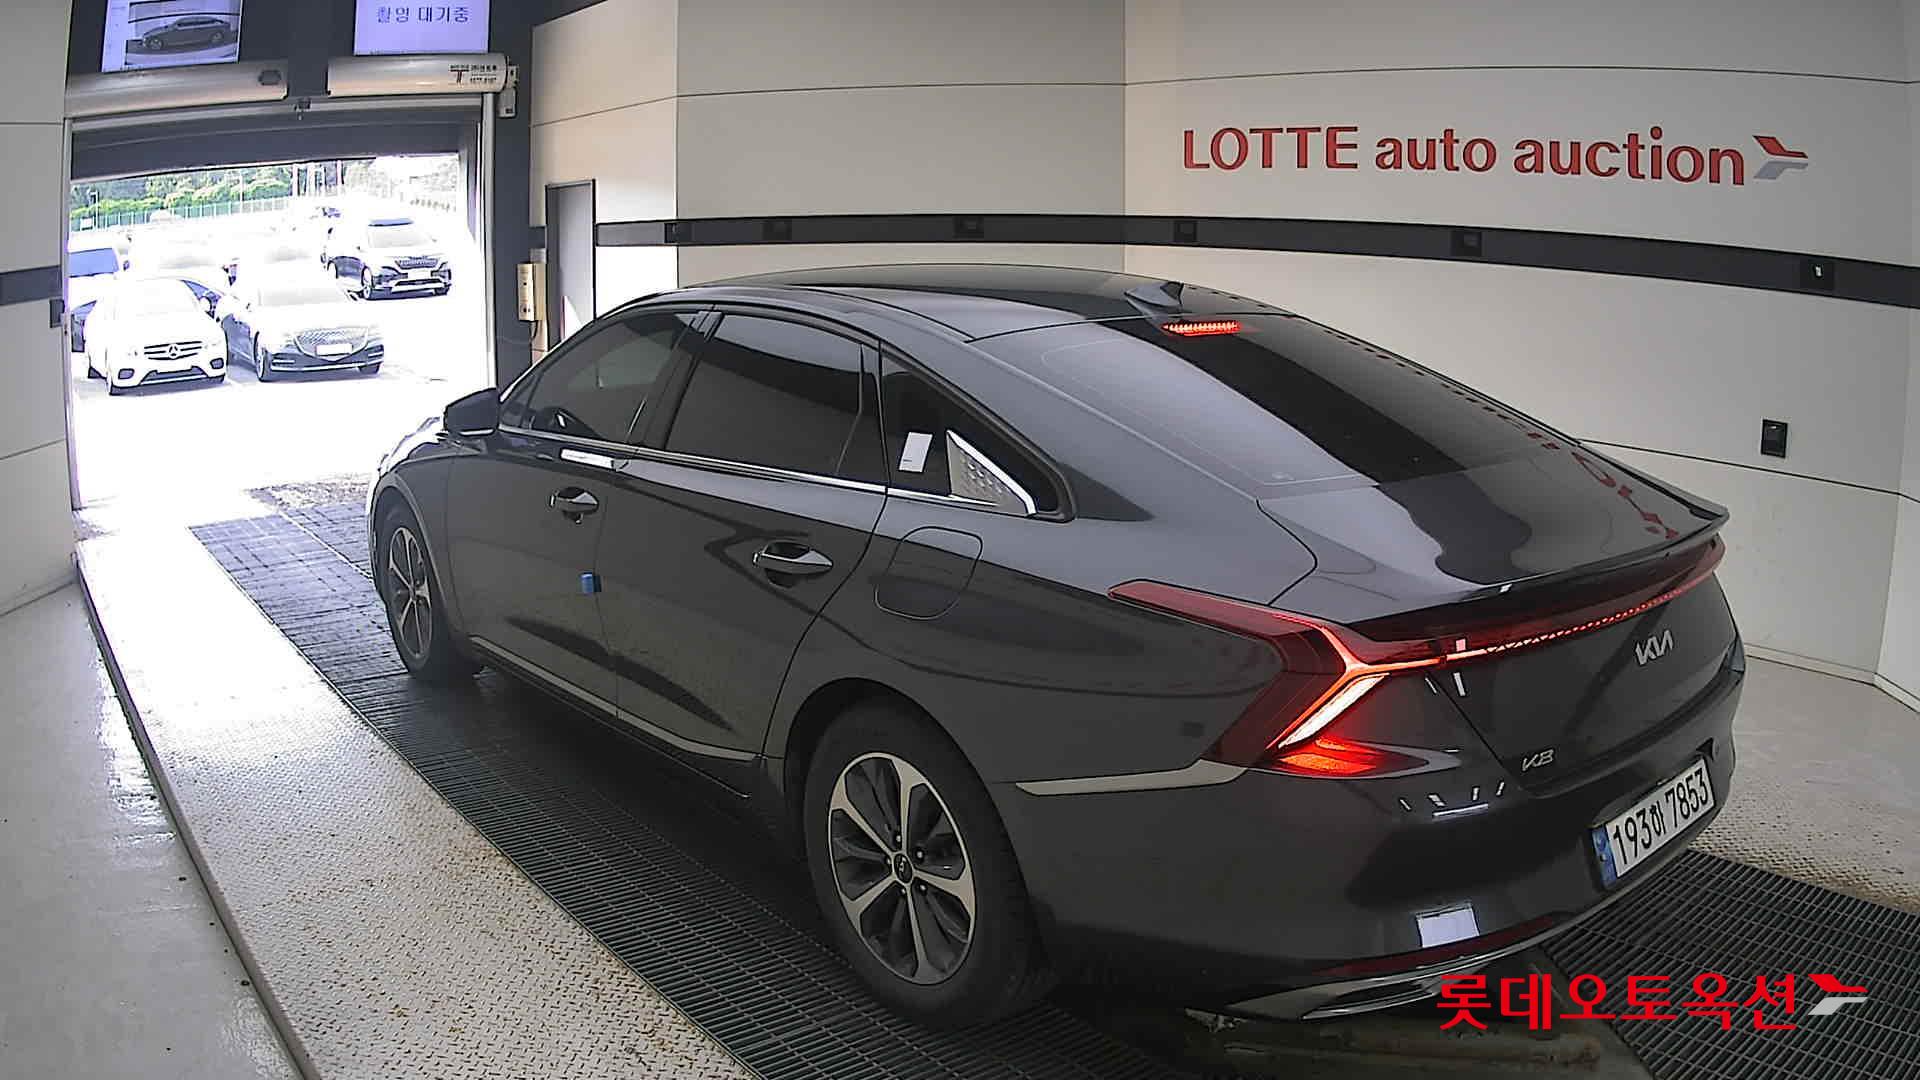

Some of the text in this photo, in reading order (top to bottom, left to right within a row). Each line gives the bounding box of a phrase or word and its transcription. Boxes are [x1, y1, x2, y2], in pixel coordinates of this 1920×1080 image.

[418, 6, 469, 23] 대기중
[1184, 127, 1744, 185] LOTTE auto auction
[1636, 630, 1673, 665] KIA
[1521, 749, 1554, 771] K8
[1614, 768, 1708, 864] 193하 7853
